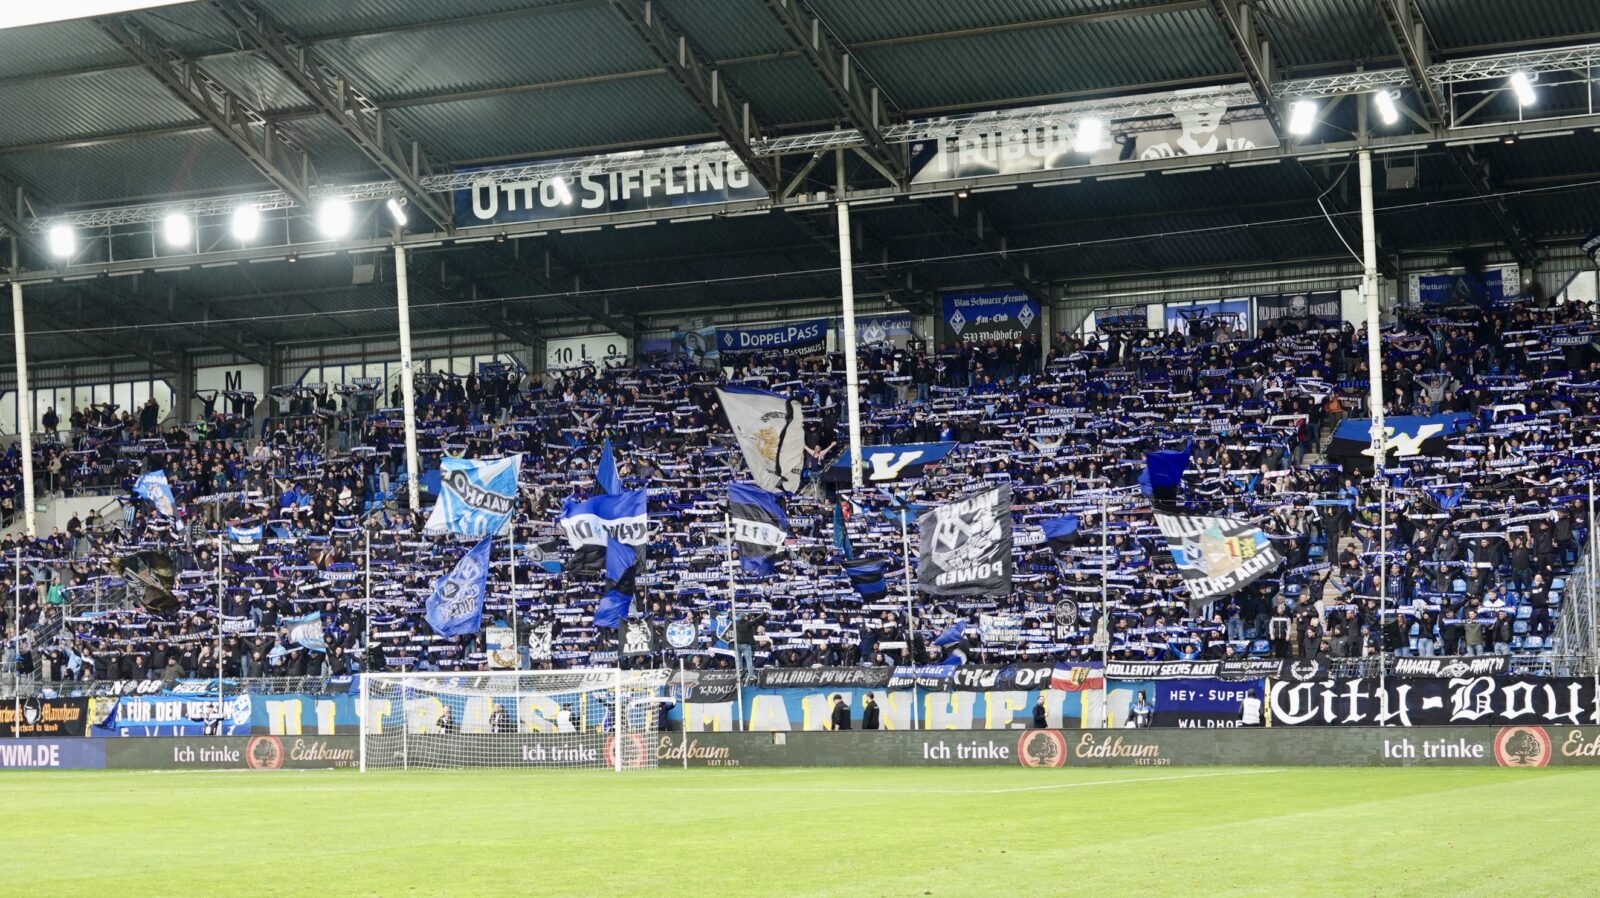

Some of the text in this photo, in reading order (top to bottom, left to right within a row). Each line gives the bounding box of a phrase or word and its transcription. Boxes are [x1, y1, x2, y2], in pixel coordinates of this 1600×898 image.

[580, 158, 750, 209] SIFFLING
[1259, 306, 1269, 321] OLD
[555, 347, 573, 364] 10
[607, 344, 617, 357] 9
[225, 371, 242, 391] M
[1106, 663, 1219, 676] KOLLEKTIV SECHS ACHT
[1170, 690, 1196, 701] HEY
[41, 703, 80, 722] Mannheim
[127, 699, 151, 722] FÜR
[156, 701, 182, 721] DEN
[0, 744, 60, 767] WM.DE
[173, 747, 240, 762] Ich trinke
[290, 738, 354, 761] Eichbaum
[522, 744, 598, 761] Ich trinke
[656, 736, 729, 760] Eichbaum
[922, 741, 1010, 760] Ich trinke
[1075, 733, 1159, 758] Eichbaum
[1383, 738, 1484, 758] Ich trinke
